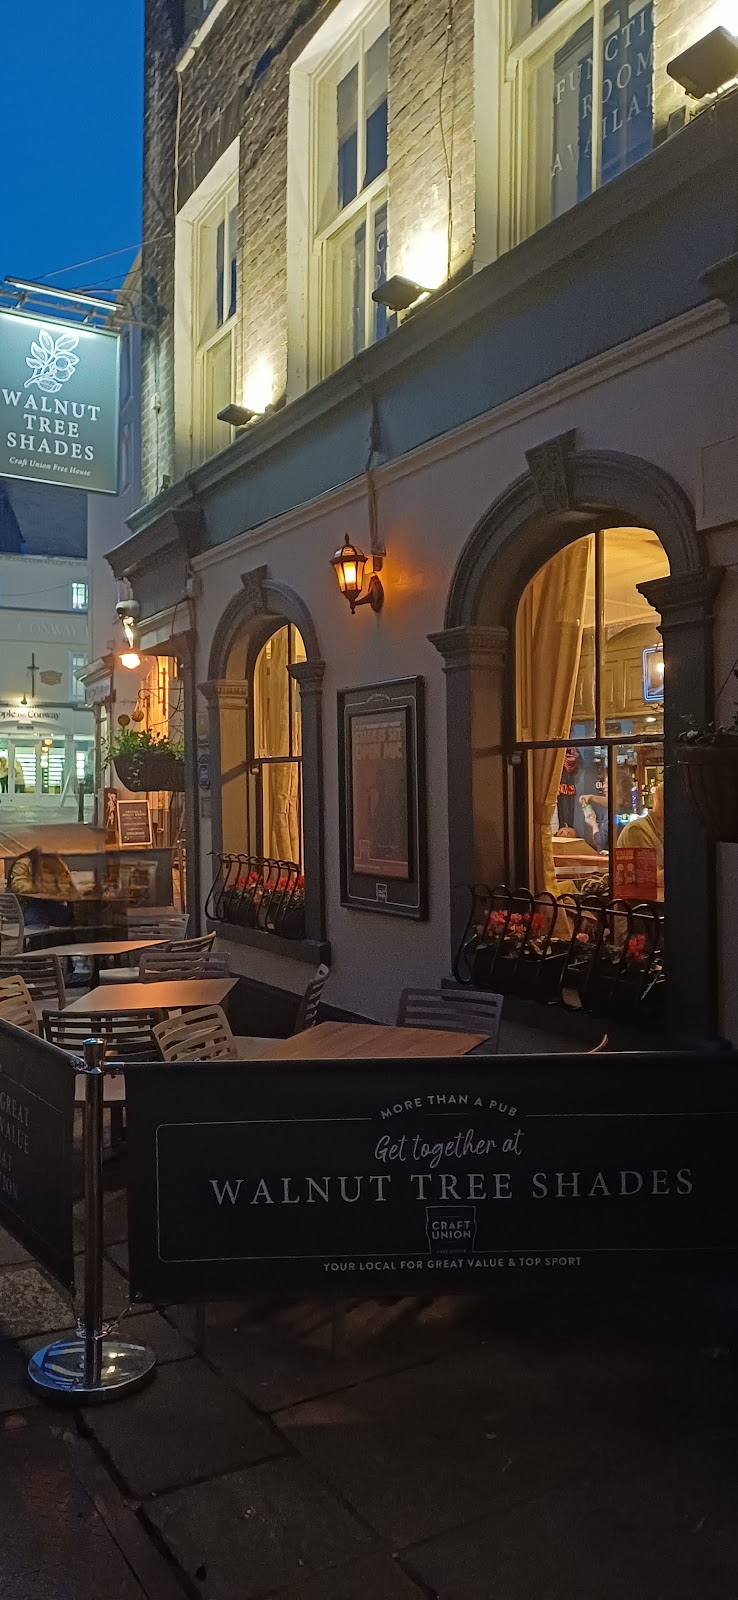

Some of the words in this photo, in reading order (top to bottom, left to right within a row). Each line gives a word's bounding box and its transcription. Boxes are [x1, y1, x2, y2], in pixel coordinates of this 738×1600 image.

[1, 388, 101, 421] WALNUT
[23, 413, 79, 438] TREE
[6, 432, 95, 461] SHADES
[9, 456, 28, 466] Craft
[29, 459, 51, 471] Union
[53, 463, 68, 473] Free
[69, 466, 91, 477] House
[27, 709, 61, 721] Conway
[381, 1097, 423, 1120] MORE
[427, 1094, 468, 1105] THAN
[473, 1096, 483, 1107] A
[489, 1099, 517, 1118] PUB
[374, 1134, 409, 1163] Get
[412, 1128, 498, 1169] together
[502, 1128, 525, 1156] at
[209, 1174, 393, 1206] WALNUT
[410, 1173, 513, 1201] TREE
[532, 1168, 695, 1198] SHADES
[431, 1220, 471, 1231] CRAFT
[431, 1230, 472, 1240] UNION
[323, 1262, 356, 1272] YOUR
[359, 1260, 396, 1271] LOCAL
[400, 1260, 423, 1270] FOR
[427, 1258, 464, 1270] GREAT
[467, 1257, 504, 1268] VALUE
[508, 1257, 516, 1267] &
[518, 1256, 542, 1267] TOP
[544, 1255, 582, 1267] SPORT
